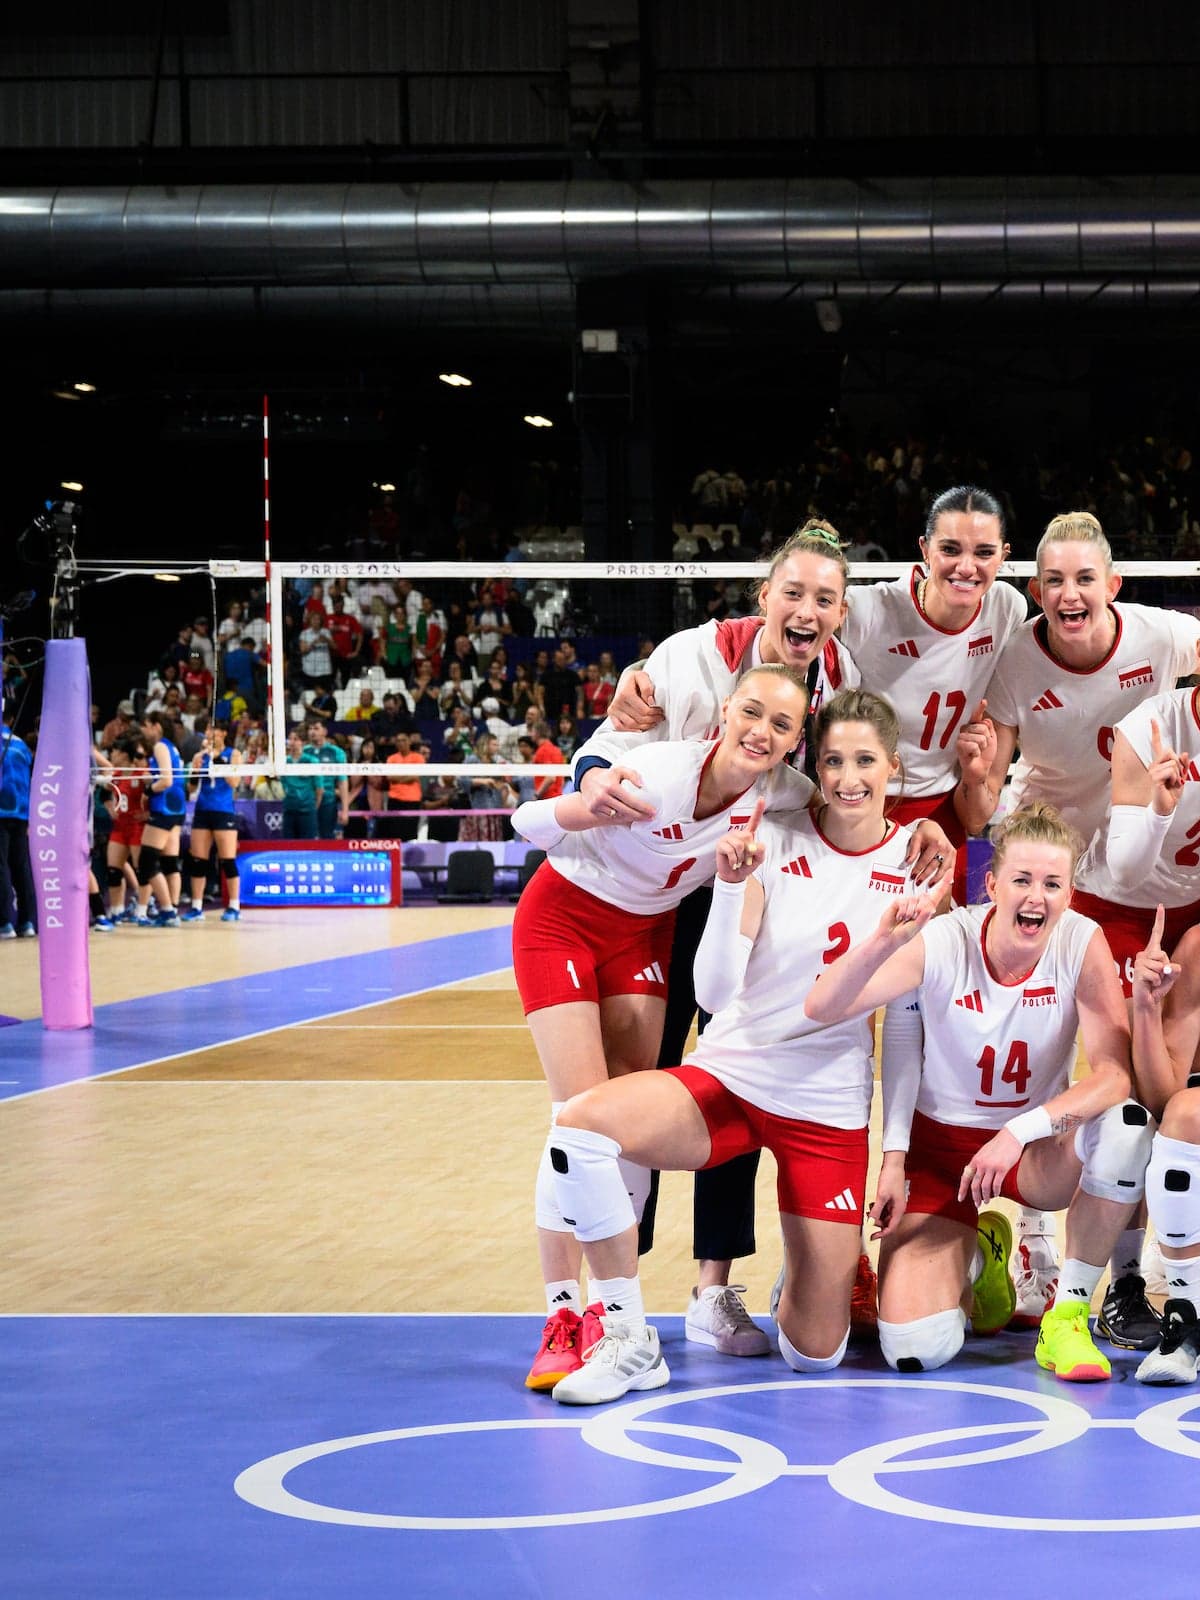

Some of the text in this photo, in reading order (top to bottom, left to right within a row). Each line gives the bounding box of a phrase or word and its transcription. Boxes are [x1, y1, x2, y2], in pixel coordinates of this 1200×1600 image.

[357, 564, 401, 574] 2024
[664, 565, 708, 575] 2024
[1119, 674, 1154, 690] POLSKA
[920, 690, 967, 750] 17
[37, 764, 63, 837] 2024
[360, 840, 400, 849] OMEGA
[868, 880, 905, 894] POLSKA
[567, 959, 580, 989] 1
[1022, 997, 1057, 1008] POLSKA
[976, 1040, 1032, 1096] 14
